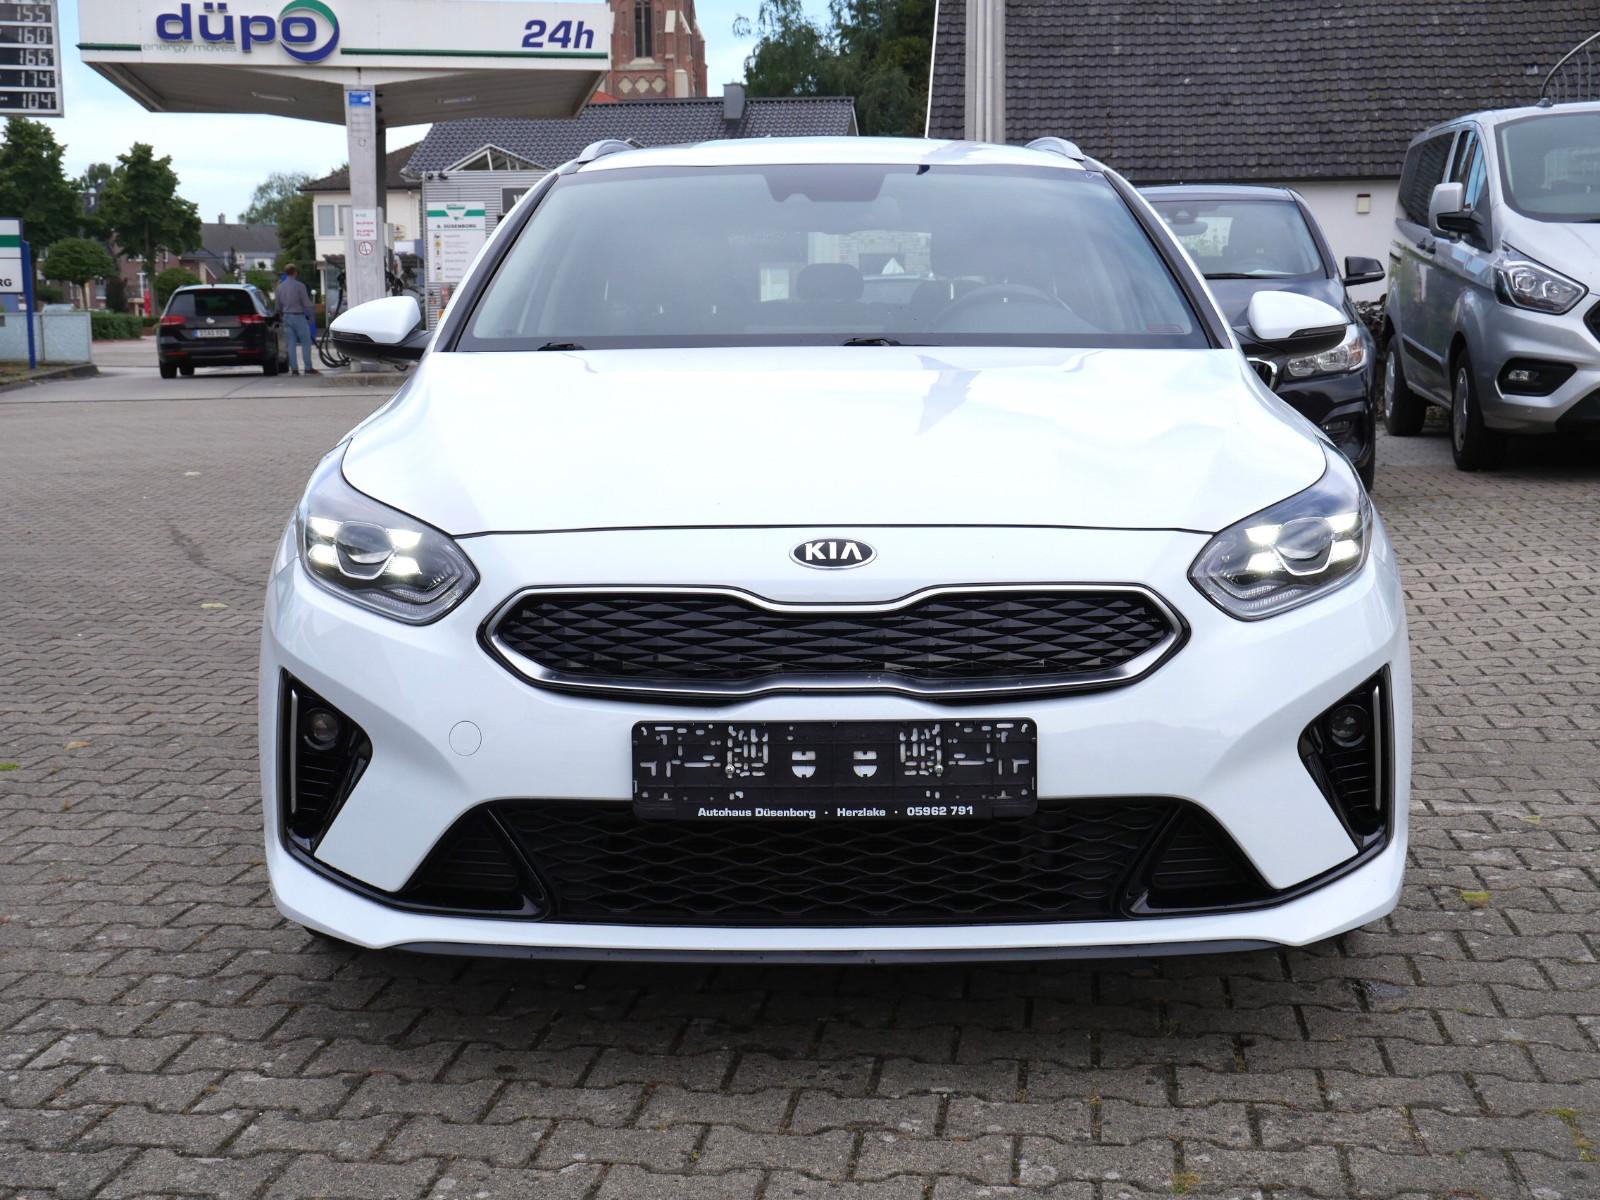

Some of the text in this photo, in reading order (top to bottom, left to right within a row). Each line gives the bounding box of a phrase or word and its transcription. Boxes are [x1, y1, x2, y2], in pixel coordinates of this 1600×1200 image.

[156, 2, 317, 53] düpo
[522, 19, 594, 49] 24h
[804, 541, 863, 561] KIA
[697, 805, 974, 819] Autohaus Düsenborg Herzlake 05962 791
